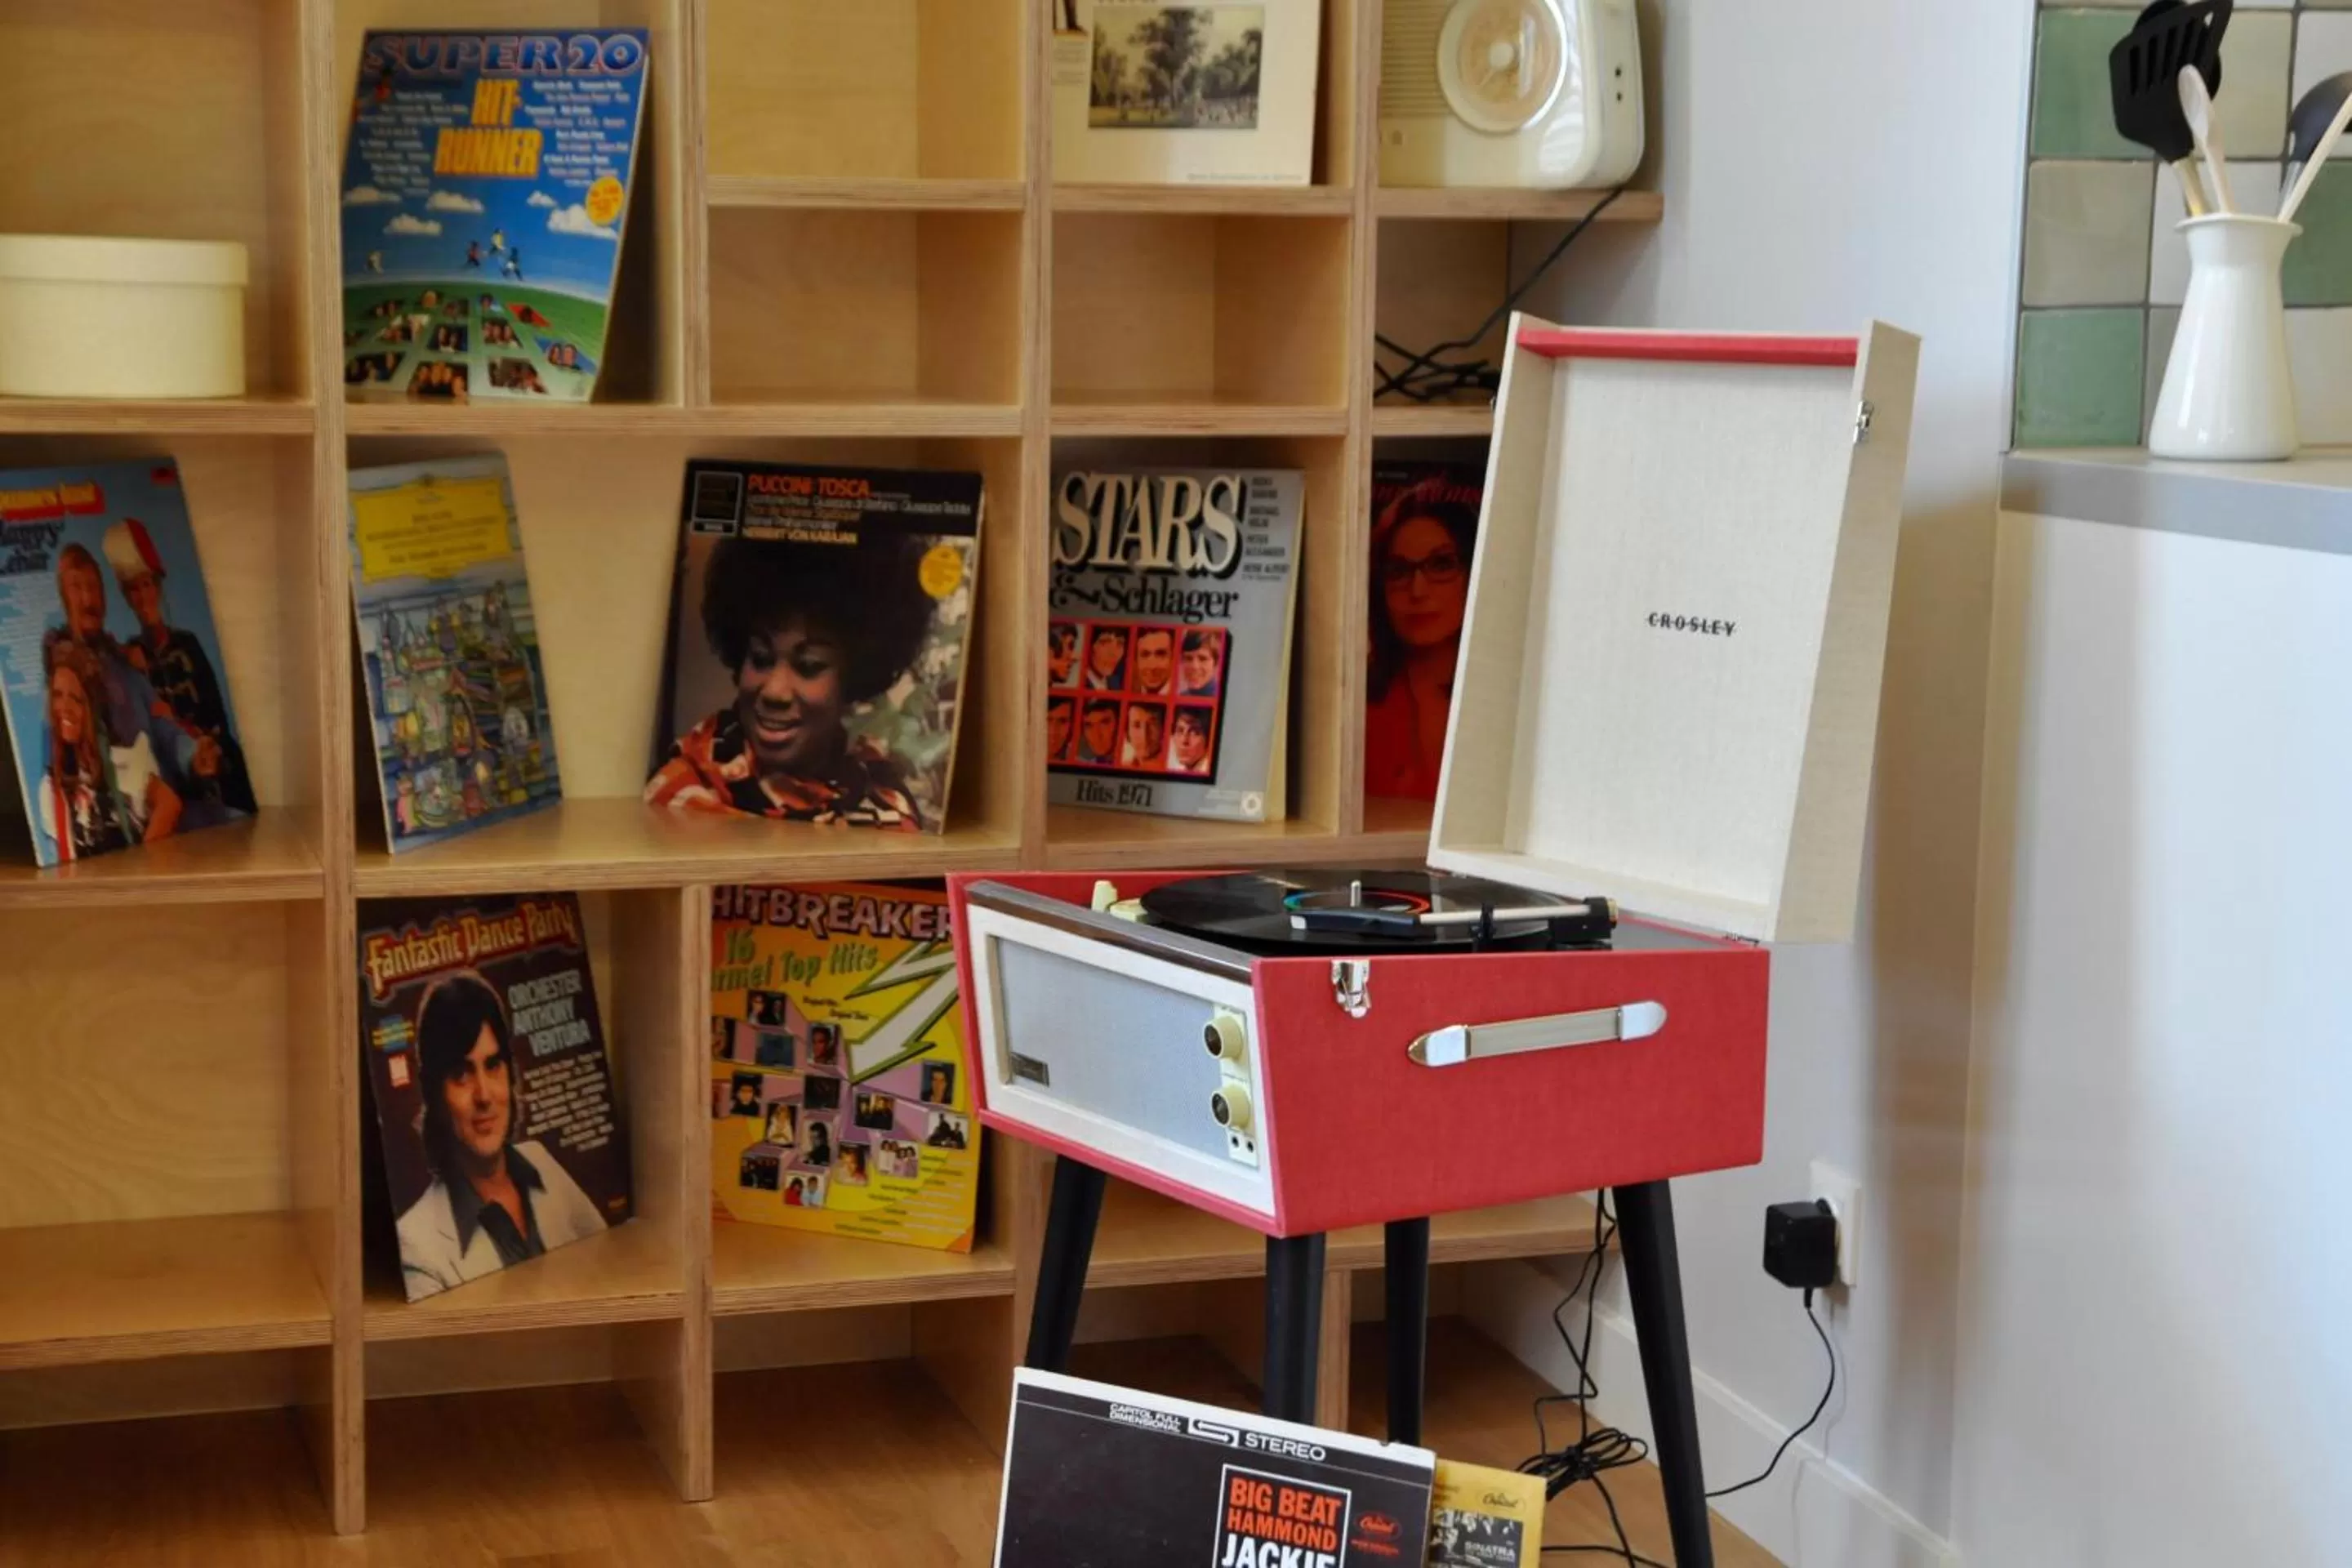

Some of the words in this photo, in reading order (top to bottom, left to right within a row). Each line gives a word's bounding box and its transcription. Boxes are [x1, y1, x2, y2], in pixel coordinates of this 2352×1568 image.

[365, 34, 564, 76] SUPER
[567, 33, 643, 75] 20
[434, 127, 543, 178] RUNNER
[747, 474, 813, 494] PUCCINI
[818, 476, 870, 499] TOSCA
[1053, 471, 1243, 575] STARS
[1102, 574, 1240, 626] Schlager
[1647, 611, 1736, 637] CROSLEY
[1076, 778, 1115, 803] Hits
[368, 923, 464, 995] Fantastic
[460, 915, 525, 959] Dance
[519, 901, 579, 945] Party
[725, 927, 755, 964] 16
[780, 950, 822, 987] Top
[829, 942, 879, 976] Hits
[1109, 1403, 1153, 1420] CAPITOL
[1155, 1413, 1182, 1427] FULL
[1109, 1411, 1182, 1433] DIMENSIONAL
[1244, 1432, 1327, 1462] STEREO
[1229, 1477, 1274, 1514] BIG
[1277, 1486, 1343, 1527] BEAT
[1227, 1508, 1338, 1552] HAMMOND
